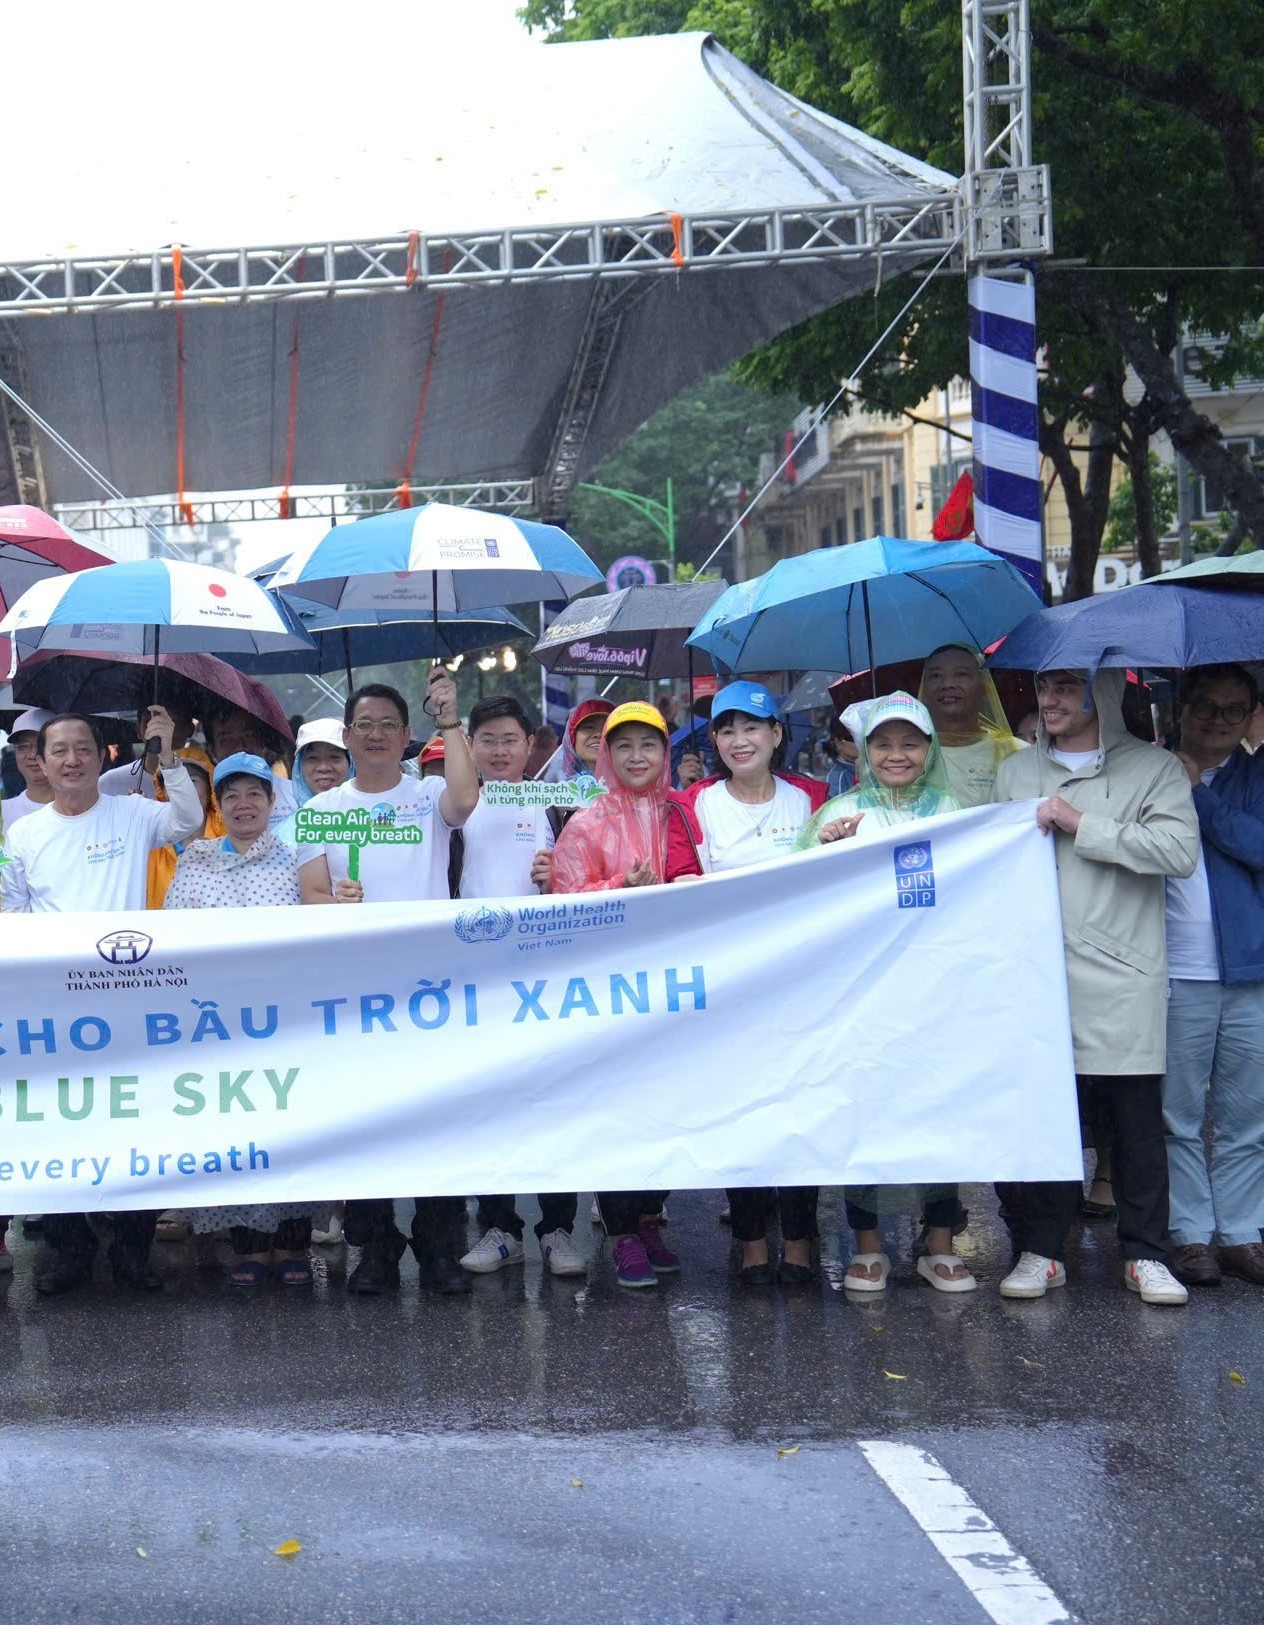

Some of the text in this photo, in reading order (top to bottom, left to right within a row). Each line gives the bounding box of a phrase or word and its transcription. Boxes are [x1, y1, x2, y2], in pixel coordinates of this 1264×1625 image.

[487, 783, 568, 796] Không khí sạch
[487, 795, 574, 807] vì từng nhịp thở
[297, 811, 370, 825] Clean Air
[297, 828, 420, 843] For every breath
[518, 900, 626, 921] World Health
[518, 913, 624, 935] Organization
[518, 937, 572, 951] Viet Nam
[89, 970, 115, 978] BAN
[118, 967, 154, 977] NHÂN
[157, 966, 184, 976] DÂN
[65, 976, 188, 991] THÀNH PHỐ HÀ NỘI
[145, 998, 279, 1046] BẦU
[311, 978, 479, 1036] TRỜI
[510, 964, 707, 1024] XANH
[172, 1067, 302, 1116] SKY
[129, 1141, 270, 1177] breath
